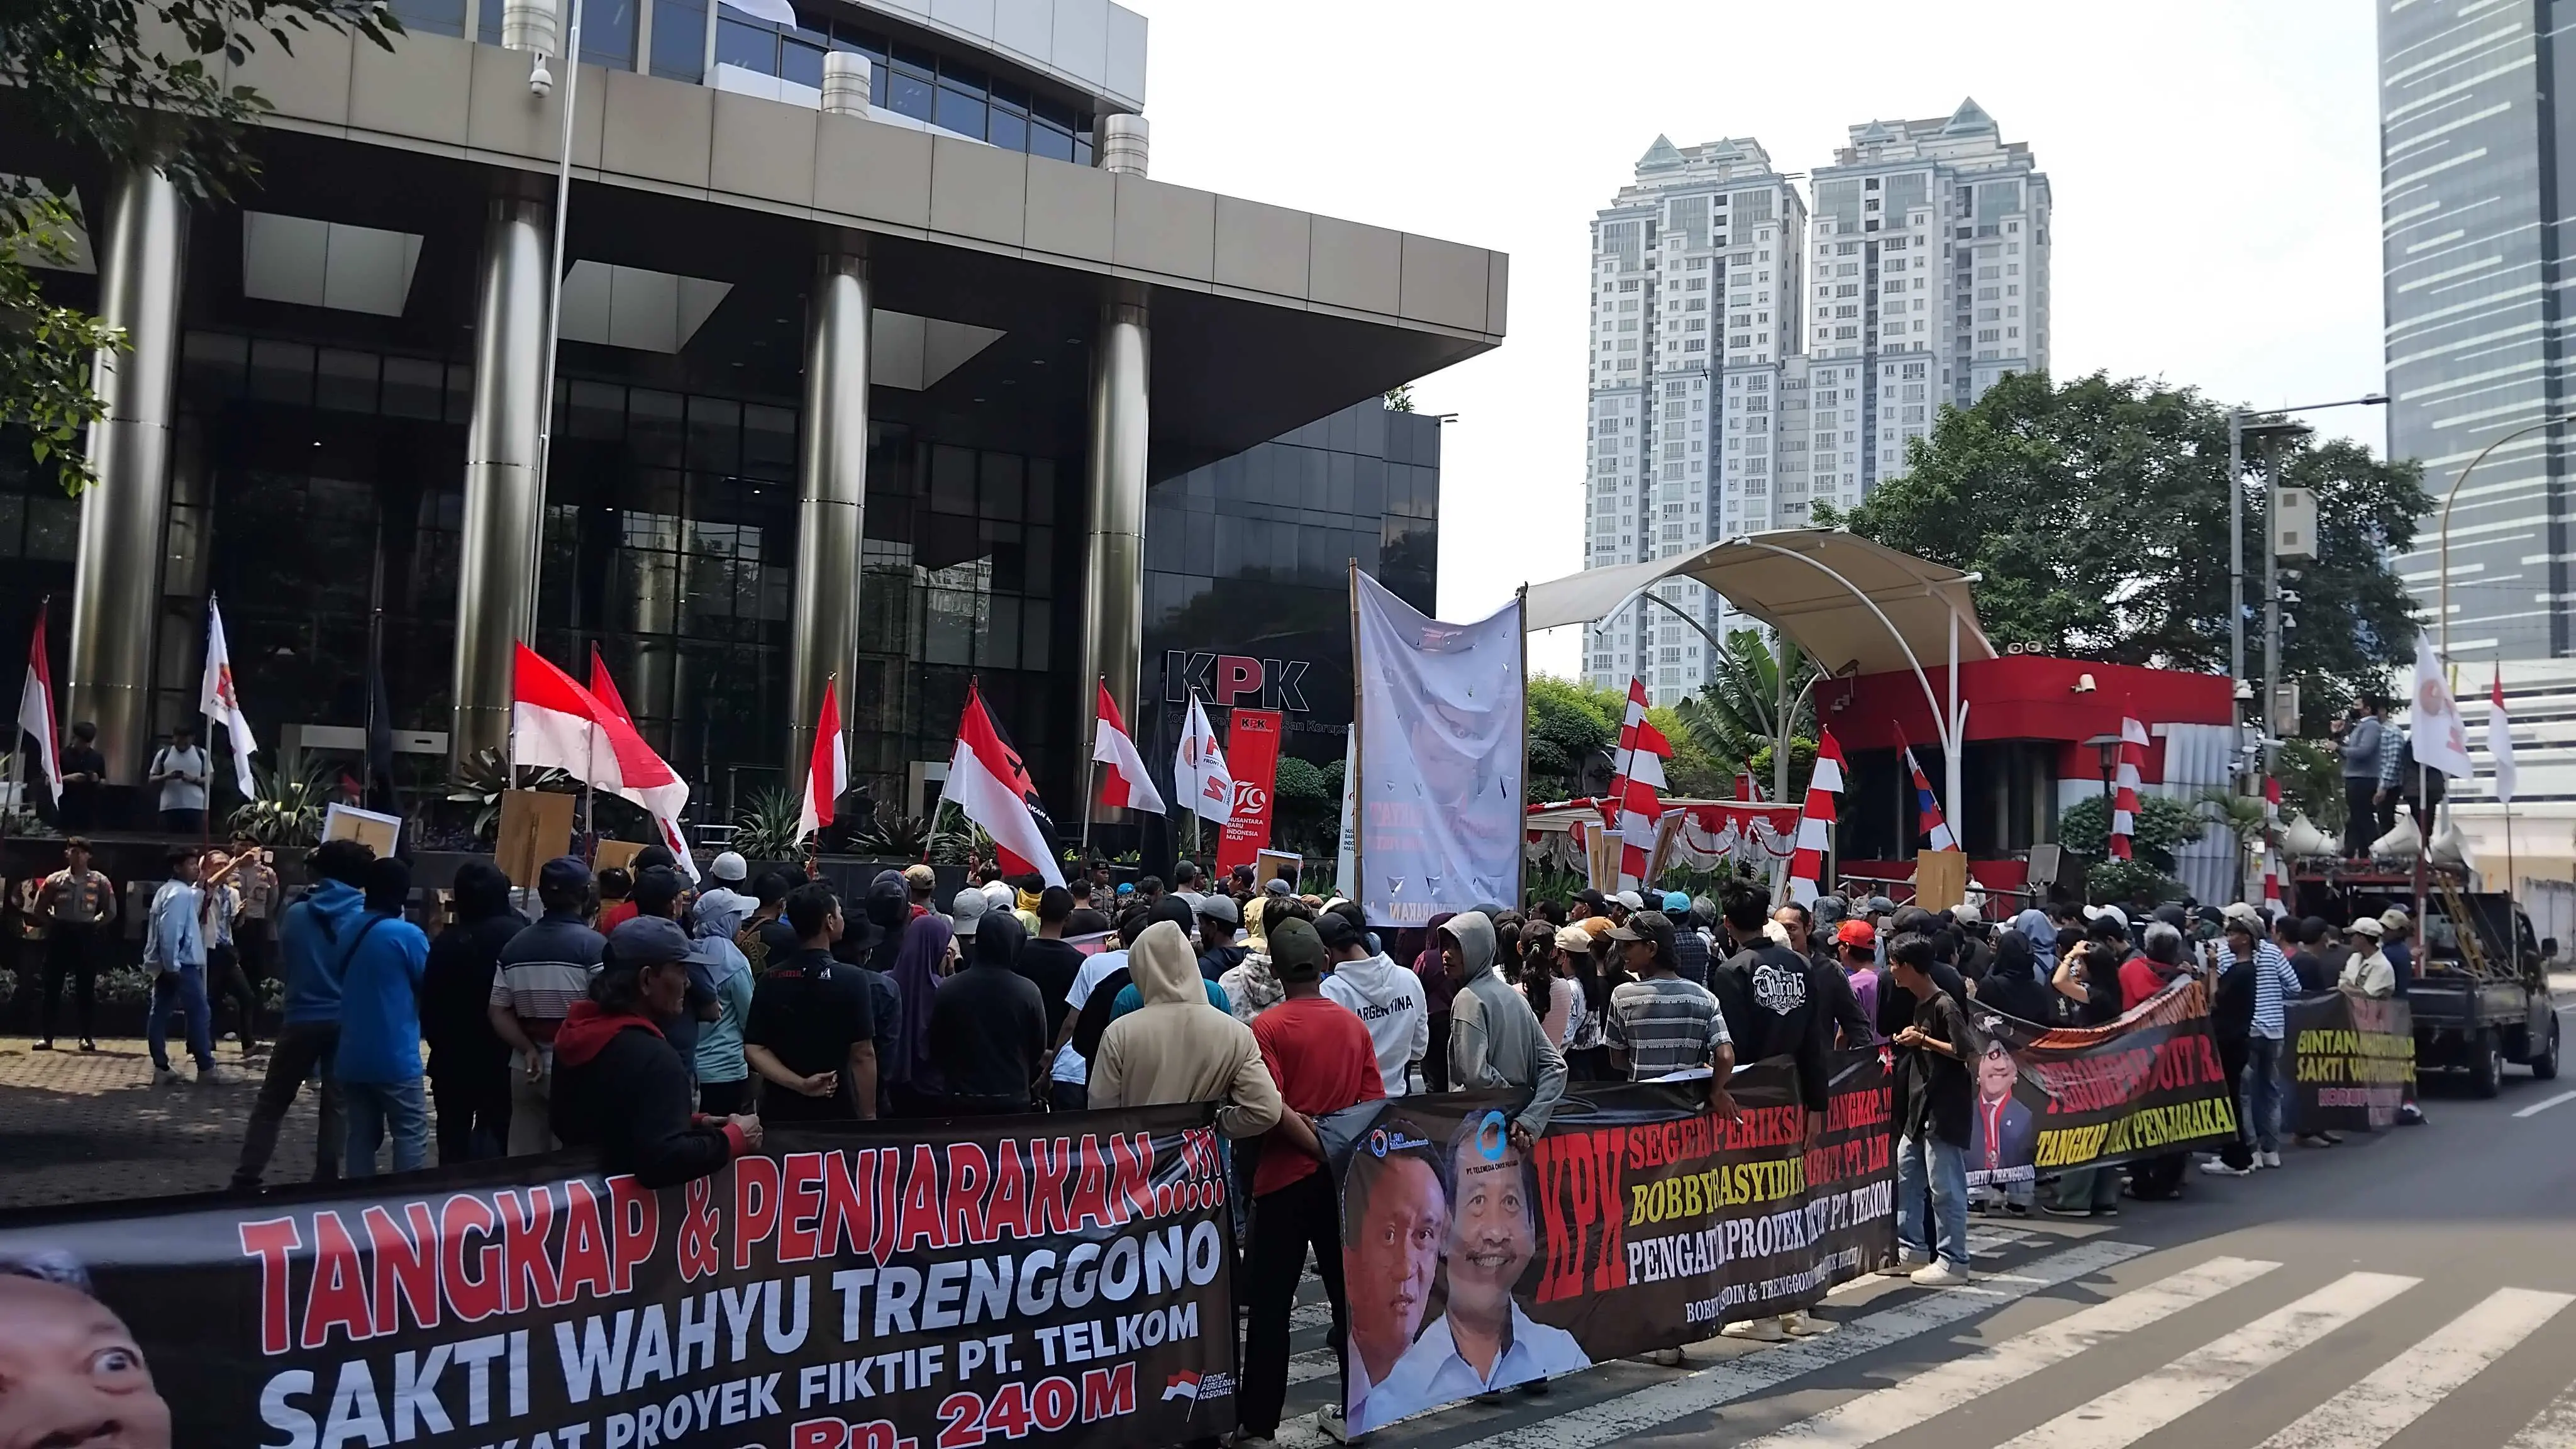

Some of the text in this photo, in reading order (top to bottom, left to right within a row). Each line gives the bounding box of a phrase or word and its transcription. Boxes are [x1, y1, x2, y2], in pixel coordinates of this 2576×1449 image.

[1166, 650, 1310, 711] KPK
[1241, 718, 1267, 729] KPK
[1307, 720, 1350, 736] Korups
[1357, 996, 1414, 1021] ARGENTINA
[2297, 1057, 2344, 1082] SAKTI
[2035, 1123, 2109, 1167] TANGKAP
[1629, 1171, 1713, 1226] BOBBY
[1711, 1155, 1805, 1208] RASYIDIN
[1804, 1145, 1841, 1187] IRUT
[1845, 1139, 1864, 1178] PT.
[1533, 1128, 1627, 1304] KPK
[1627, 1223, 1725, 1285] PENGATR
[1726, 1209, 1806, 1260] PROYEK
[1830, 1192, 1848, 1230] PT.
[1852, 1179, 1892, 1225] TELKOM
[239, 1174, 660, 1355] TANGKAP
[678, 1175, 720, 1284] &
[1685, 1296, 1720, 1323] BOBBY
[1748, 1282, 1757, 1302] &
[1760, 1269, 1814, 1301] TRENGGONO
[260, 1220, 1220, 1449] SAKTI WAHYU TRENGGONO
[606, 1371, 782, 1449] PROYEK
[800, 1344, 944, 1409] FIKTIF
[959, 1334, 1022, 1380] PT.
[1035, 1301, 1199, 1367] TELKOM
[1198, 1387, 1233, 1400] NASIONAL
[1204, 1372, 1227, 1384] FRONT
